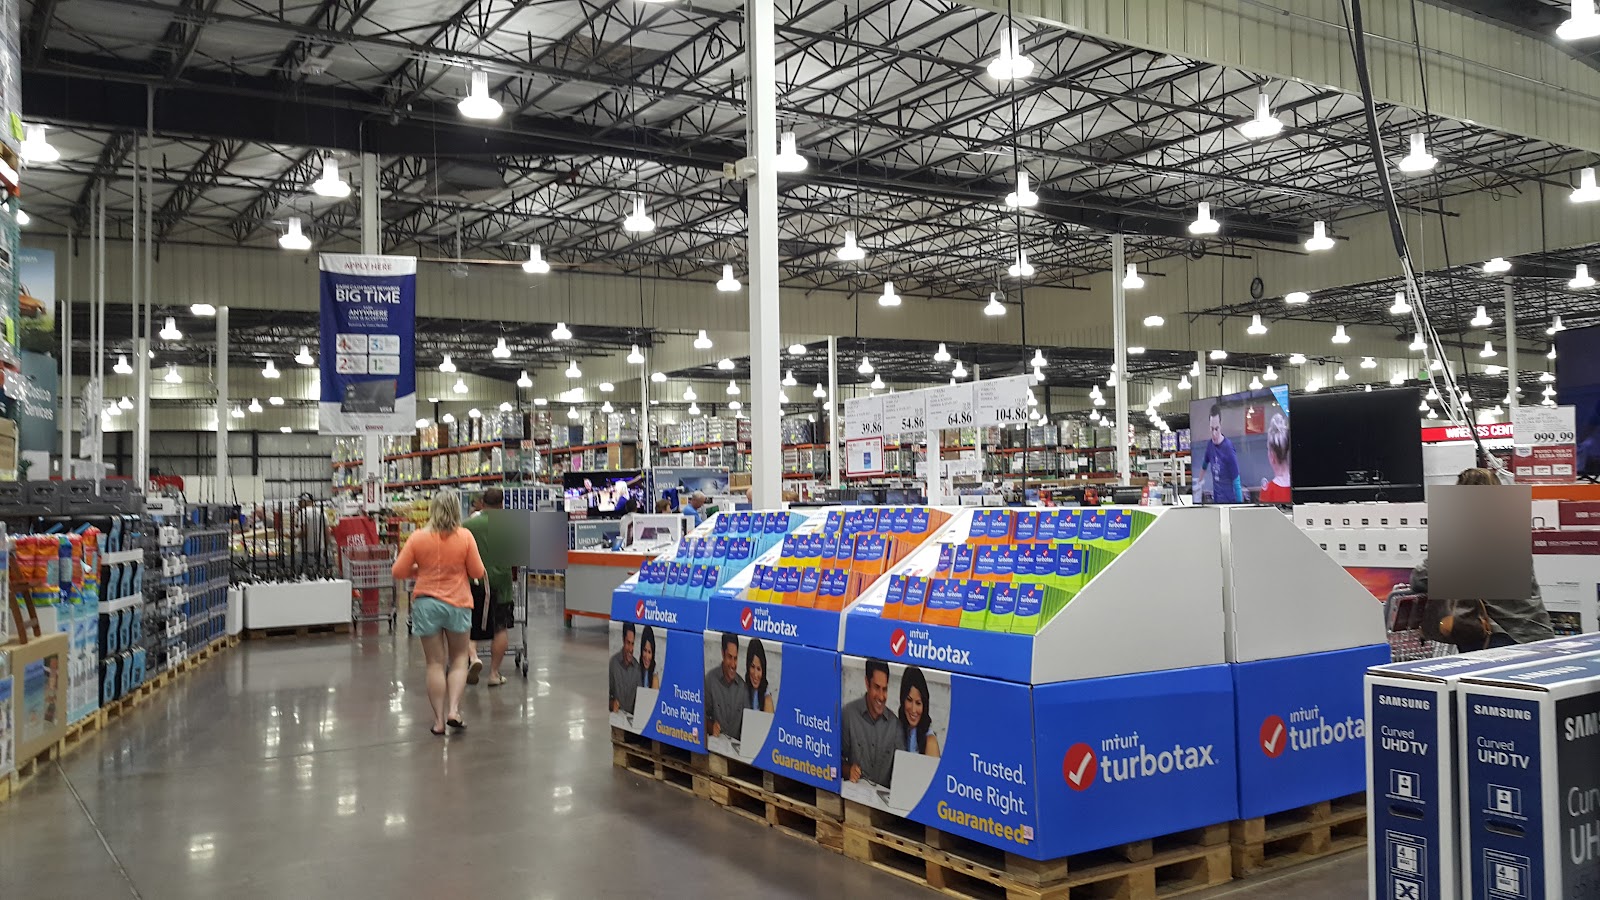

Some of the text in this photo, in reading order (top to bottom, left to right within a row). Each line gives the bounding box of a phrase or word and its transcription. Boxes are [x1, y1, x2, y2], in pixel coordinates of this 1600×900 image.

[345, 262, 392, 271] APPLY HERE
[336, 289, 400, 304] BIG TIME
[348, 309, 388, 317] ANYWHERE
[947, 411, 972, 426] 64.86
[996, 407, 1027, 421] 104.86
[861, 421, 882, 435] 39.86
[901, 417, 924, 431] 54.86
[1534, 431, 1574, 443] 999.99
[644, 606, 678, 624] turbotax
[752, 615, 798, 638] turbotax
[907, 638, 971, 666] turbotax
[673, 684, 702, 704] Trusted.
[1379, 694, 1431, 711] SAMSUNG
[661, 700, 702, 726] Done Right.
[793, 708, 833, 733] Trusted.
[1289, 704, 1319, 723] intuit
[1473, 704, 1532, 721] SAMSUNG
[1380, 725, 1415, 740] Curved
[1564, 711, 1600, 742] SAM
[778, 727, 833, 758] Done Right.
[1101, 731, 1140, 752] intuit
[1476, 736, 1515, 752] Curved
[771, 749, 833, 782] Guaranteed.
[970, 752, 1027, 785] Trusted.
[1100, 743, 1215, 784] turbotax
[946, 775, 1028, 816] Done Right.
[1568, 786, 1600, 818] Cur
[936, 800, 1029, 846] Guaranteed.
